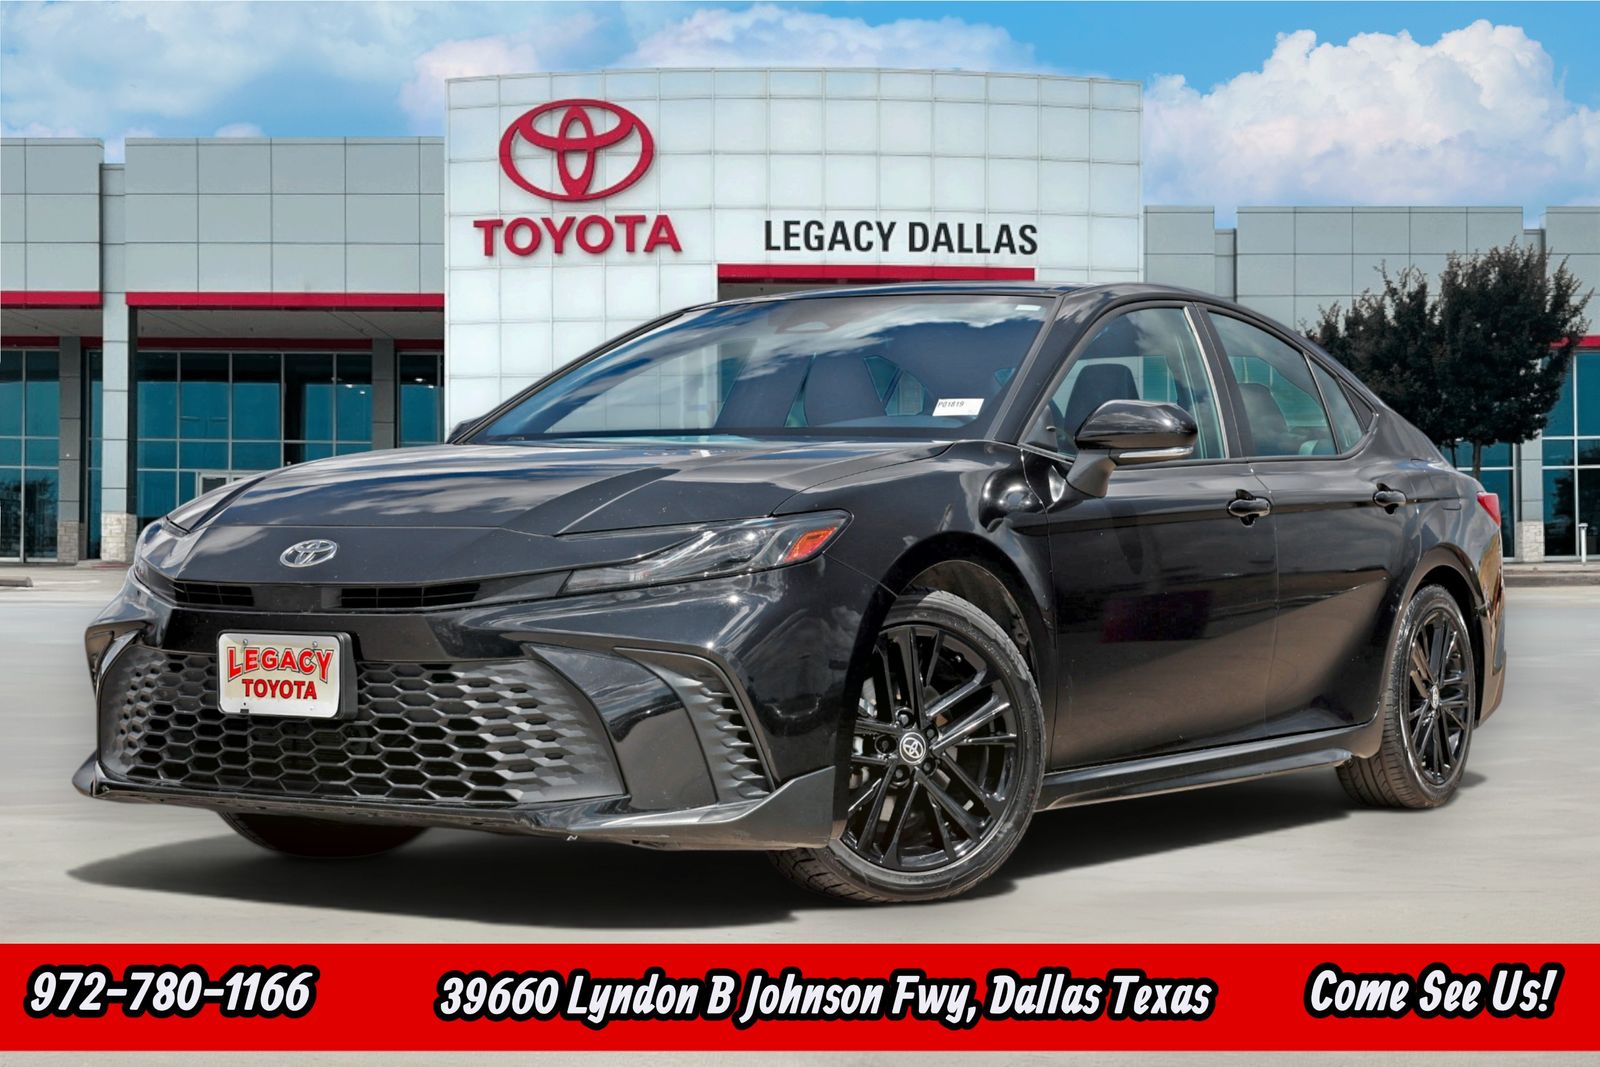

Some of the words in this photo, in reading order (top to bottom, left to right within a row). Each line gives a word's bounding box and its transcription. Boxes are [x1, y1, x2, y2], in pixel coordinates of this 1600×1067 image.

[474, 214, 682, 257] TOYOTA
[765, 220, 897, 252] LEGACY
[908, 221, 1038, 255] DALLAS
[226, 646, 334, 684] LEGACY
[241, 678, 318, 700] TOYOTA
